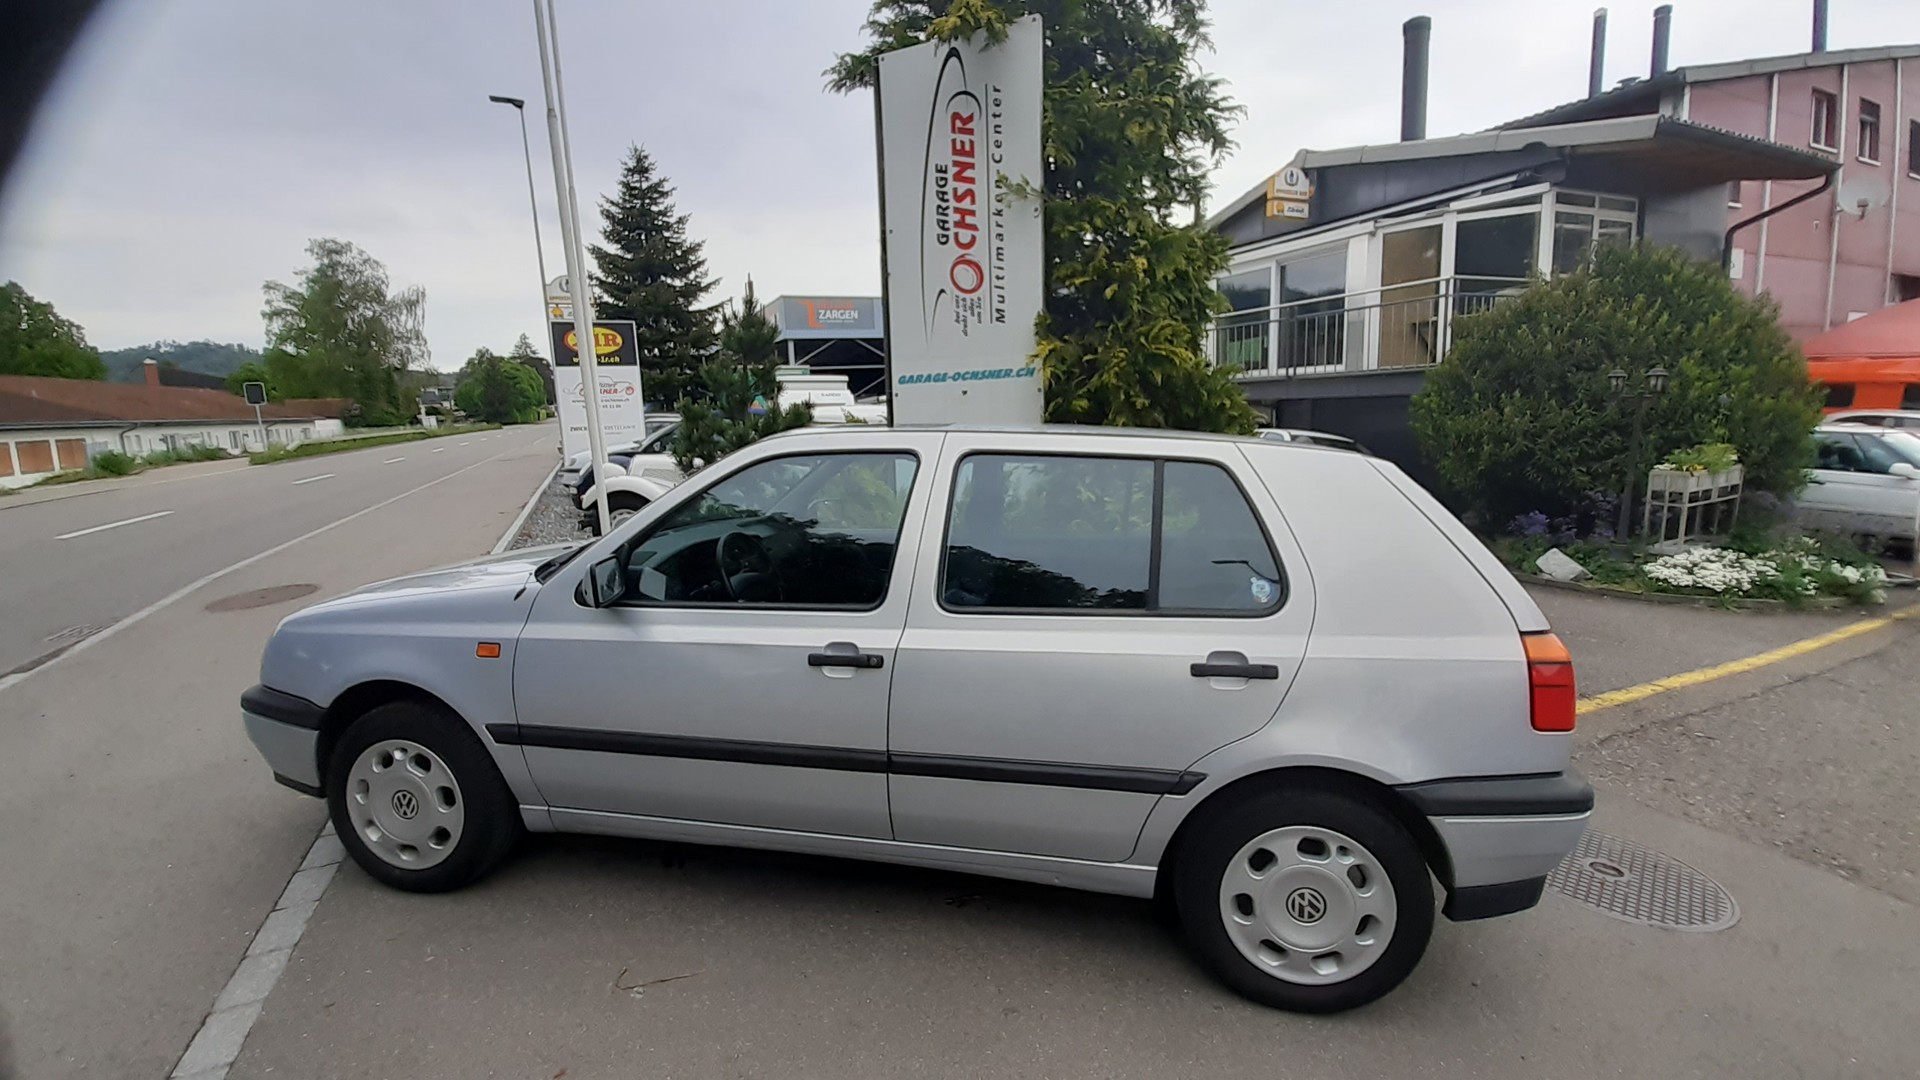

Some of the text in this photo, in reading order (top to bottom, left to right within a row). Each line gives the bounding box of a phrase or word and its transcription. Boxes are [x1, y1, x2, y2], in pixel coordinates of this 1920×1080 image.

[936, 164, 950, 245] GARAGE
[950, 111, 984, 294] OCHSNER
[818, 309, 858, 320] ZARGEN
[897, 367, 1036, 385] GARAGE-OCHSNER.CH
[392, 790, 419, 820] VW
